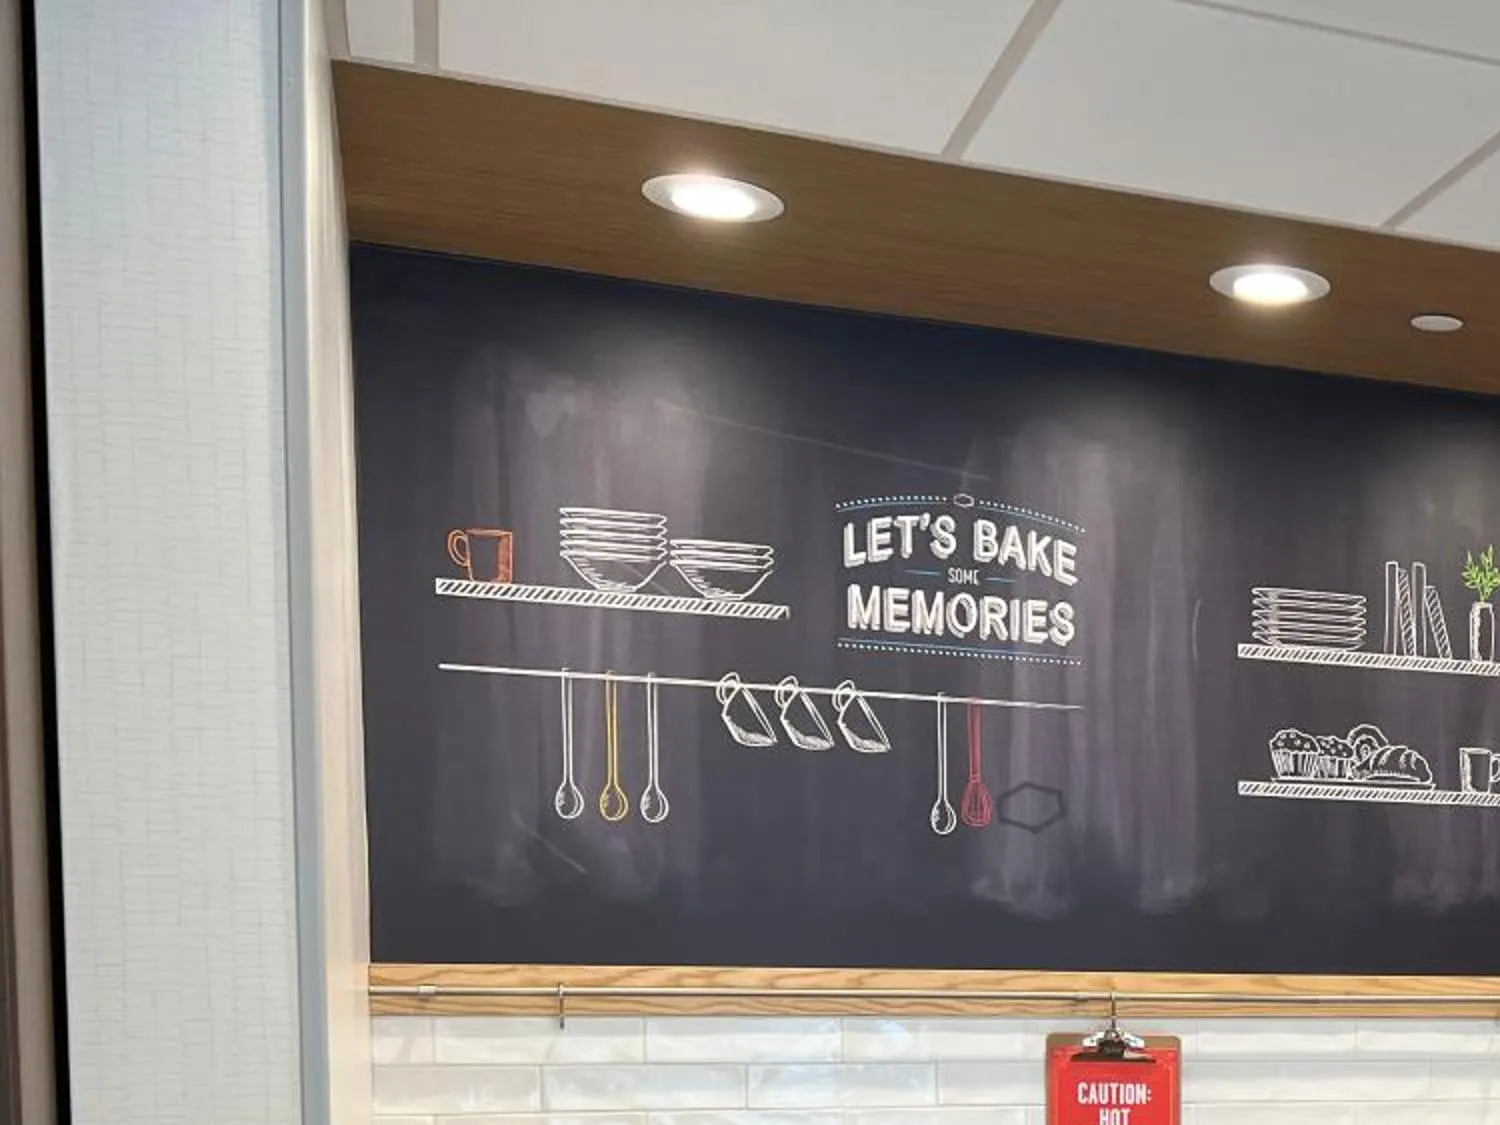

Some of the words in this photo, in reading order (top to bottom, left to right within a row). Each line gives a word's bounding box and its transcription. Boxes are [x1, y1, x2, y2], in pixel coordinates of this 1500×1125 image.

[843, 513, 957, 567] LET'S
[972, 518, 1078, 586] BAKE
[948, 568, 980, 585] SOME
[847, 584, 1075, 646] MEMORIES
[1077, 1081, 1152, 1104] CAUTION:
